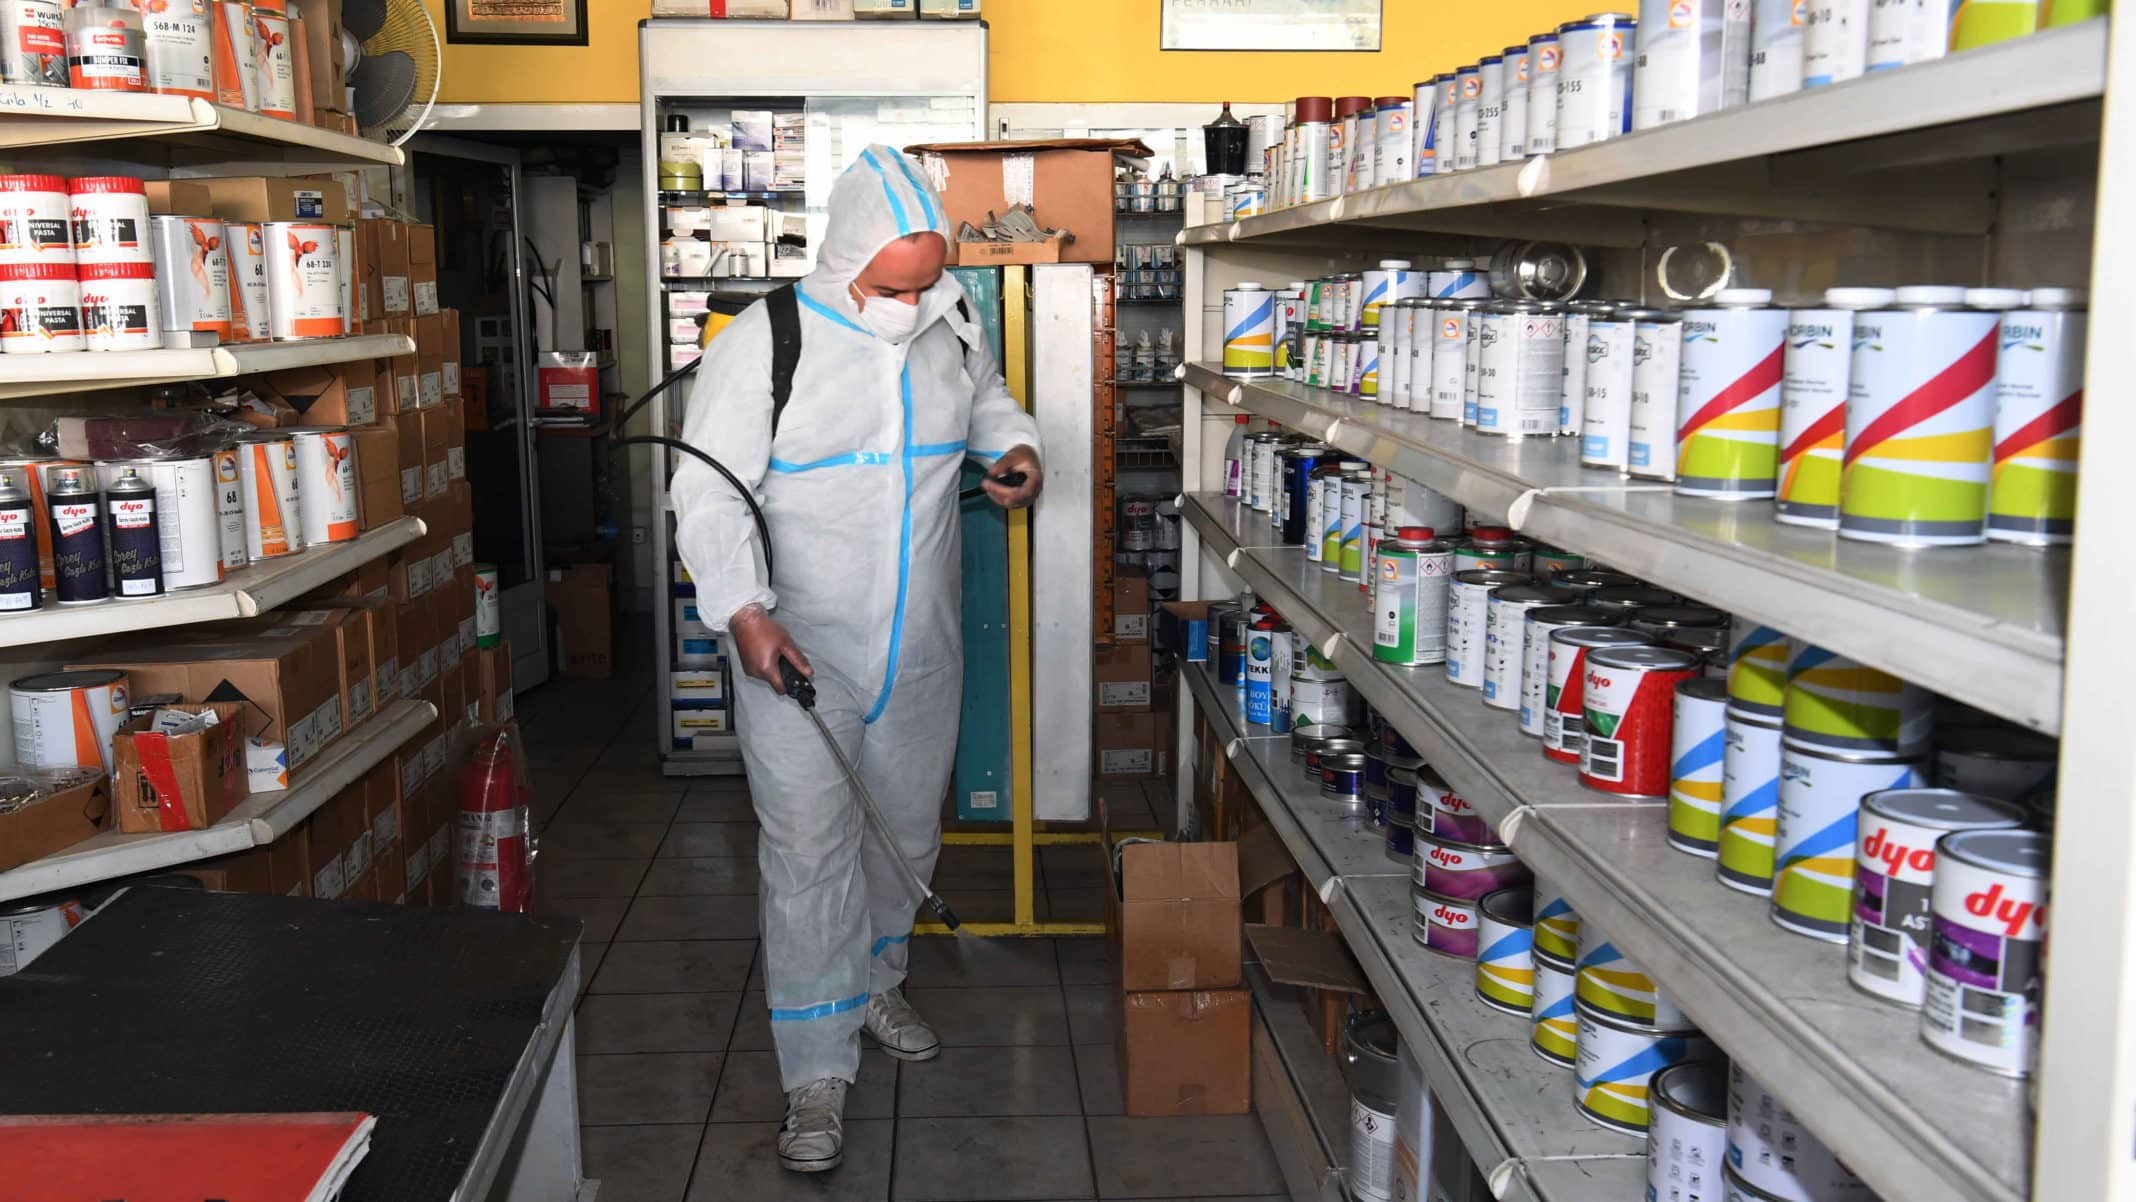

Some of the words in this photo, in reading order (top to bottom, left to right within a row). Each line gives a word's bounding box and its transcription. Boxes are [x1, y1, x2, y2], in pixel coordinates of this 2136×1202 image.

[182, 24, 196, 34] 124
[226, 491, 237, 504] 68
[62, 507, 87, 517] dyo
[119, 501, 144, 512] dyo
[0, 513, 18, 523] yo
[1587, 670, 1611, 689] dyo
[1430, 847, 1463, 866] dyo
[1864, 828, 1936, 877] dyo
[1434, 905, 1468, 925] dyo
